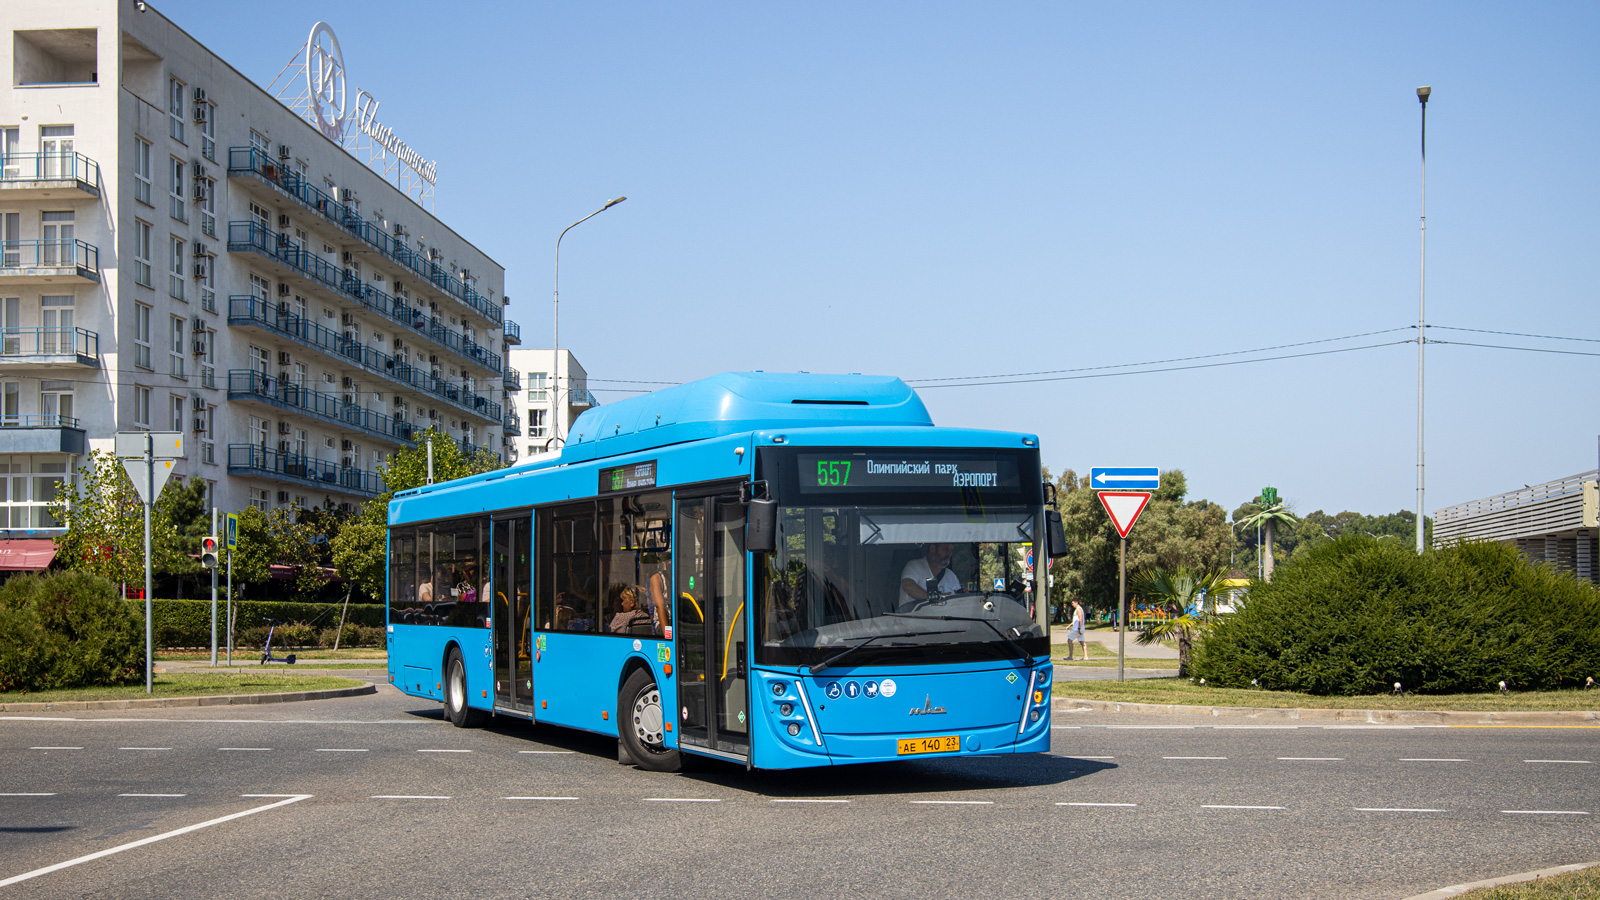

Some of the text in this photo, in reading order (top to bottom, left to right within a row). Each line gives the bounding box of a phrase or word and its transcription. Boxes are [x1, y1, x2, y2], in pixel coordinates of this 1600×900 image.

[817, 461, 851, 486] 557
[867, 459, 958, 475] Олимпийский парк
[953, 472, 998, 487] АЭРОПОРТ
[921, 739, 940, 751] 140
[946, 737, 956, 746] 23
